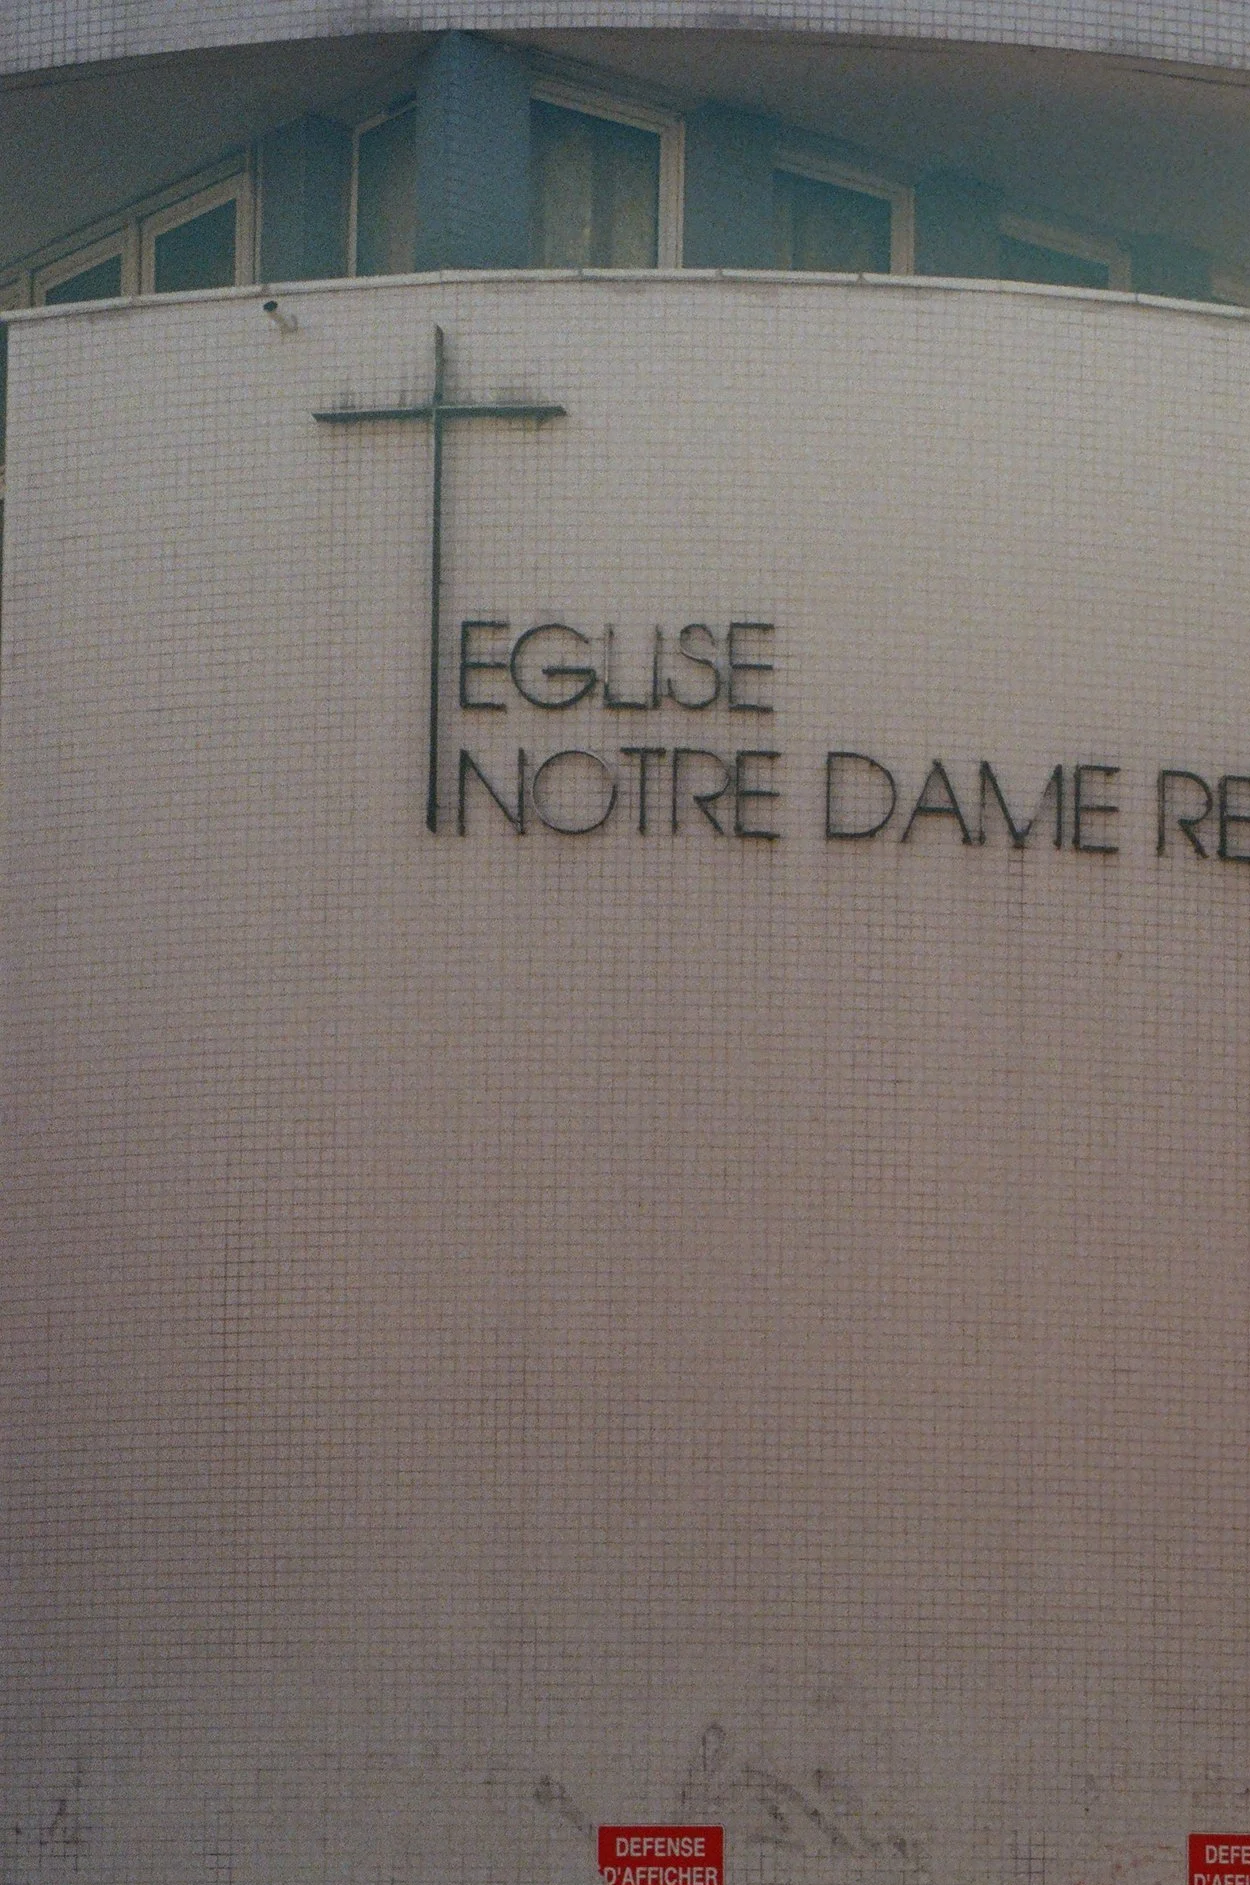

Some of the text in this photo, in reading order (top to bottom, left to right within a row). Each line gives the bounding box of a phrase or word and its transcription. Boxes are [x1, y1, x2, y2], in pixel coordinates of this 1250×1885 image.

[461, 621, 774, 712] EGLISE
[458, 747, 781, 841] NOTRE
[826, 750, 1120, 854] DAME
[615, 1837, 706, 1857] DEFENSE
